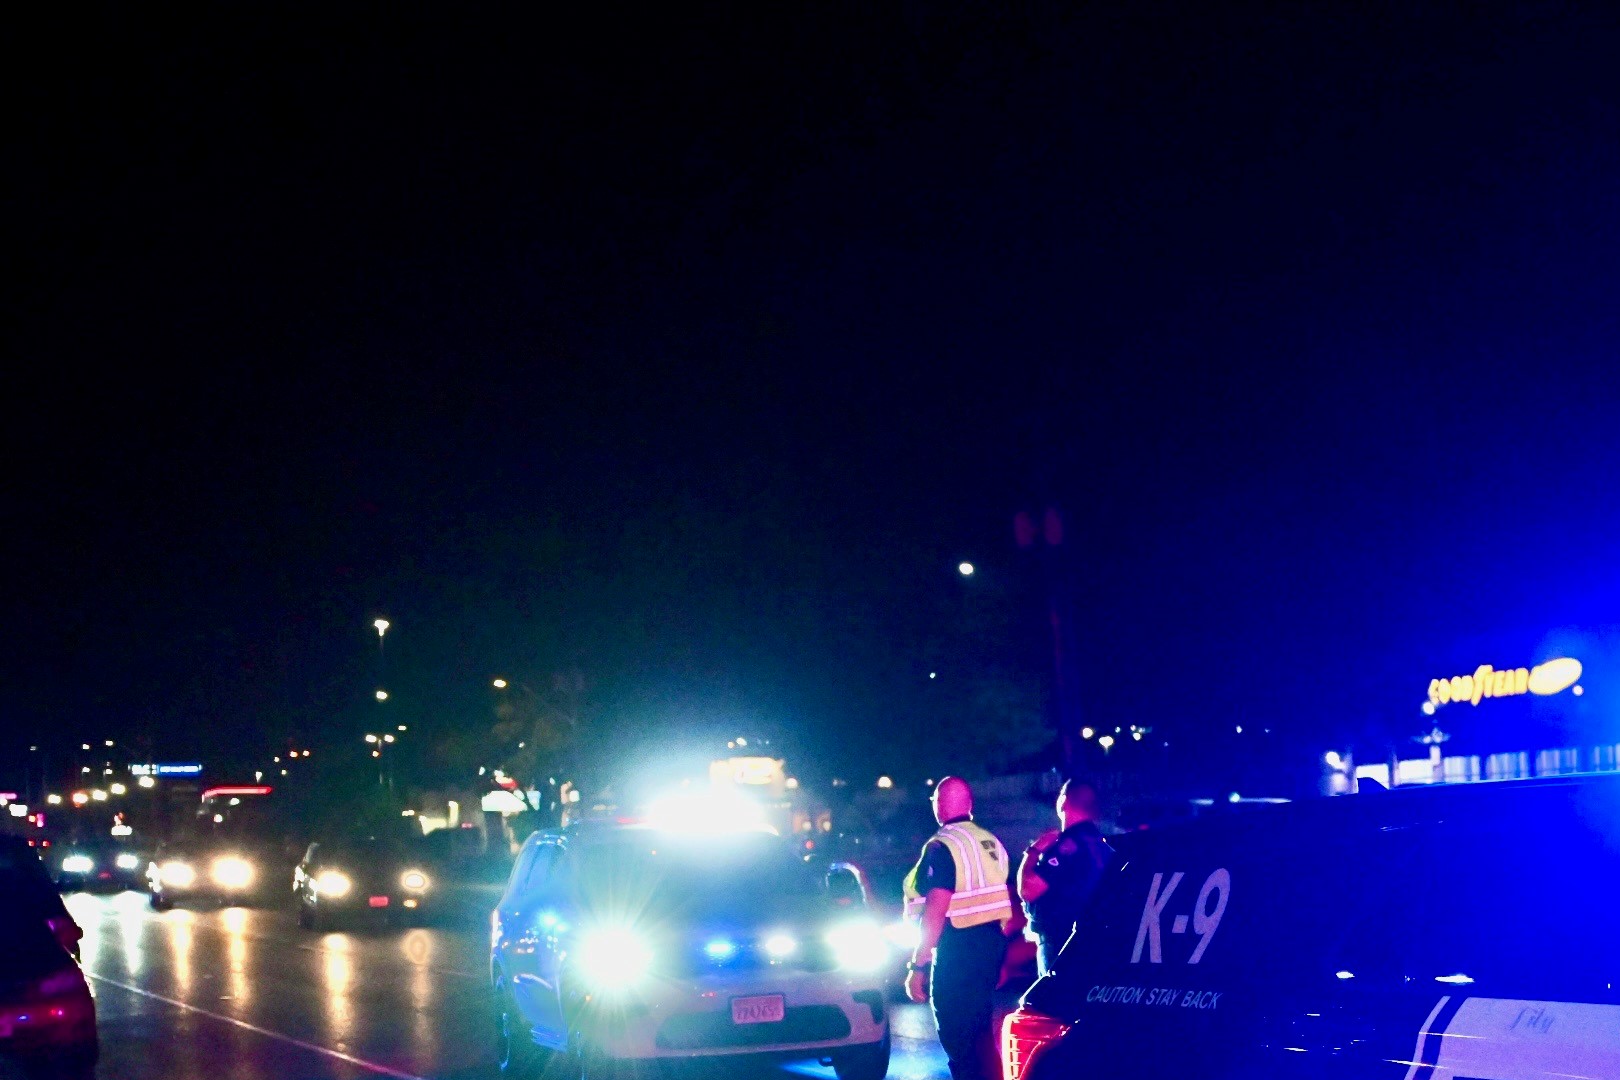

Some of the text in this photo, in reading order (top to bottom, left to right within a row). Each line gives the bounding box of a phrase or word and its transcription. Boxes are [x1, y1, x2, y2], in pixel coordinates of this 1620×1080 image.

[1130, 868, 1231, 965] K-9
[1086, 985, 1223, 1010] CAUTION STAY BACK
